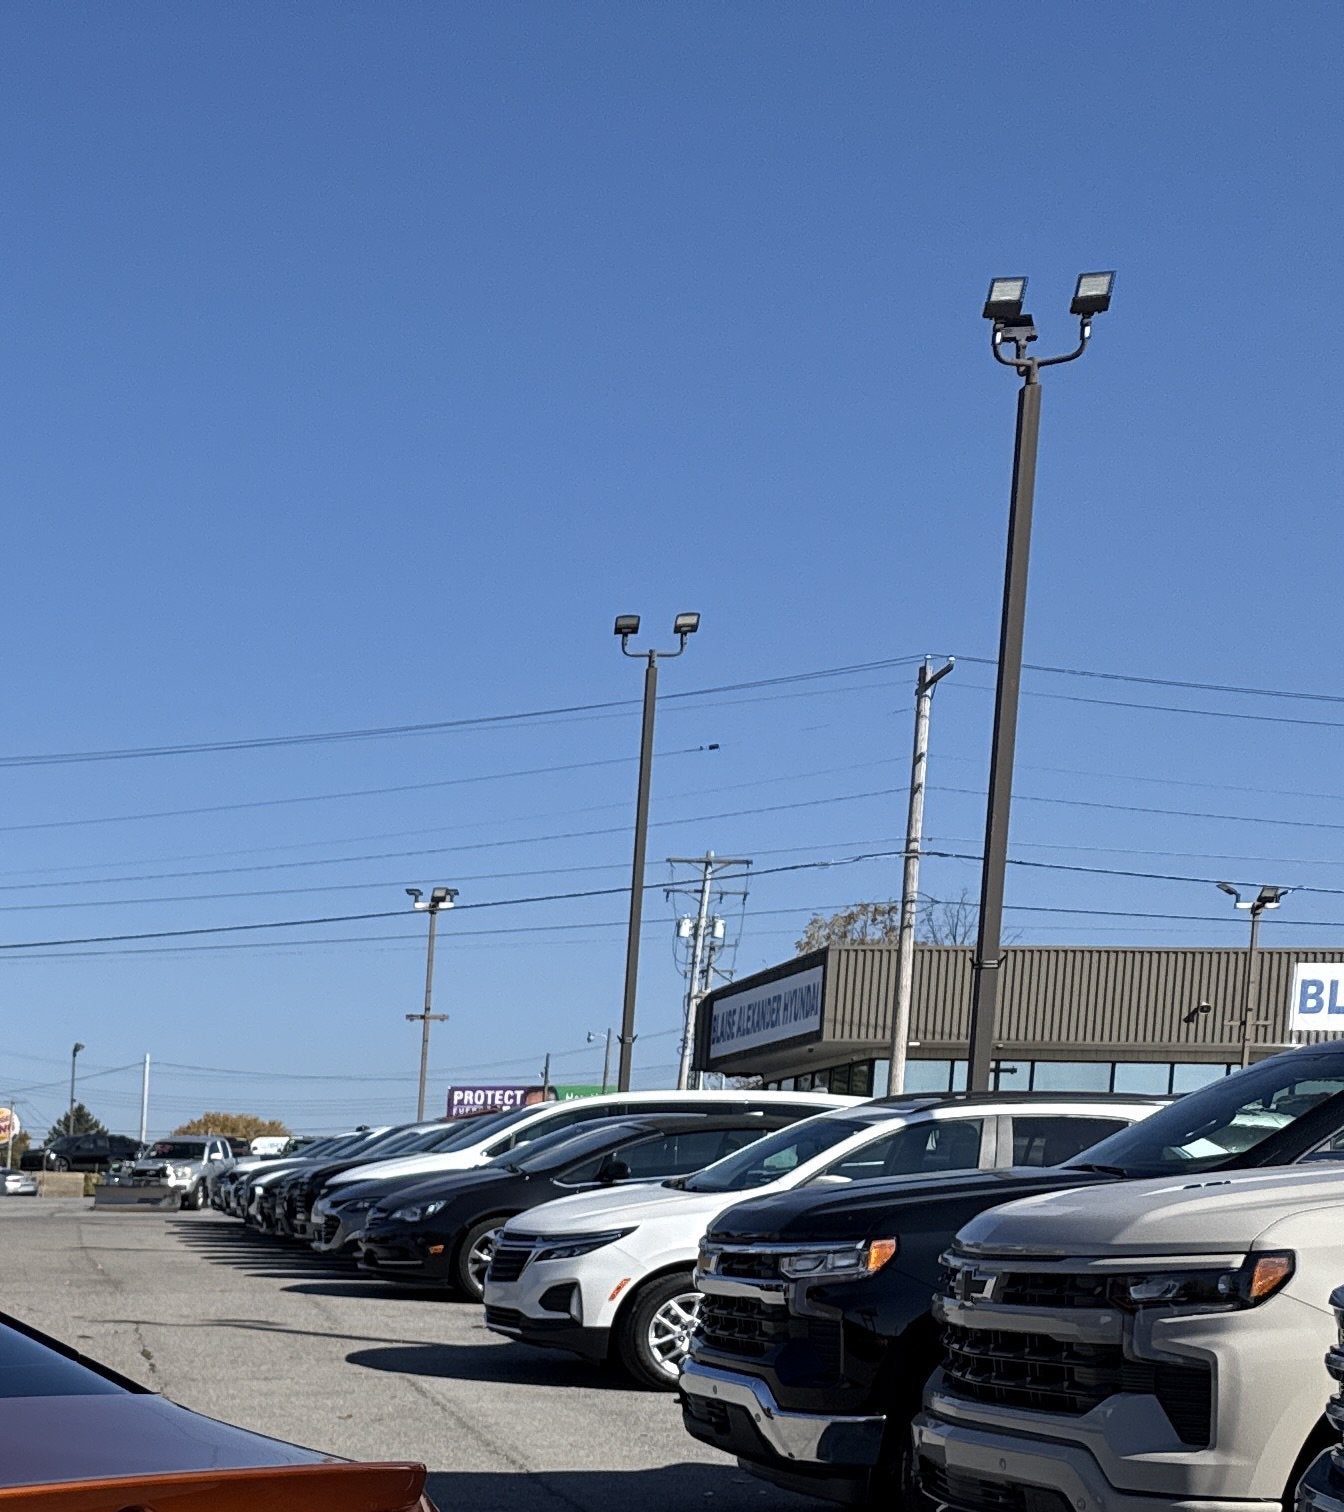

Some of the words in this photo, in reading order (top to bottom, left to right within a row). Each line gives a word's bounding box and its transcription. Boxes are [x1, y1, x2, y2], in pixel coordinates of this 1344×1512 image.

[712, 1007, 737, 1045] BLAISE
[736, 994, 782, 1038] ALEXANDER
[782, 981, 820, 1026] HYUNDAI
[1299, 979, 1344, 1014] BL
[453, 1090, 524, 1105] PROTECT
